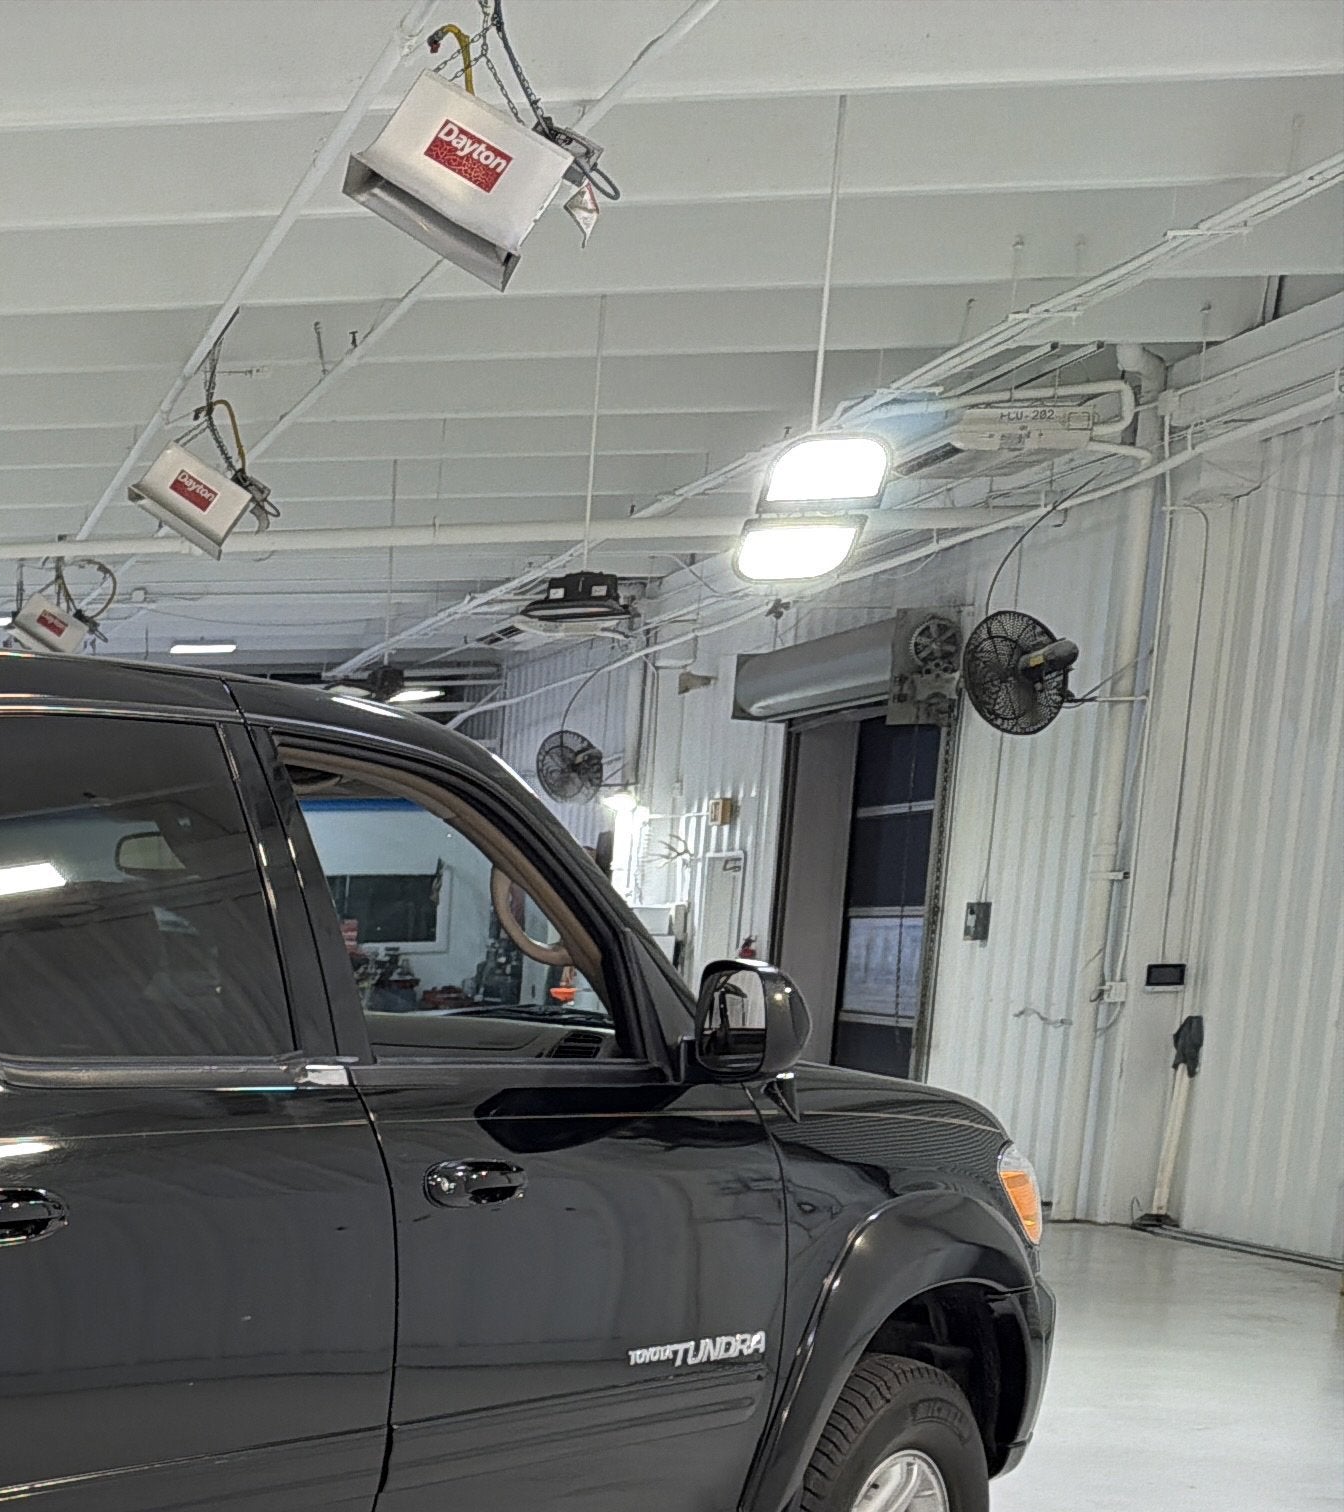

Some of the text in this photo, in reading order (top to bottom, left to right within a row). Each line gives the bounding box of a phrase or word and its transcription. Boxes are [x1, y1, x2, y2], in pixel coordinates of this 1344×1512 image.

[438, 122, 509, 174] Dayton
[178, 472, 215, 502] Dayton
[628, 1331, 766, 1367] TOYOTA TUNDRA
